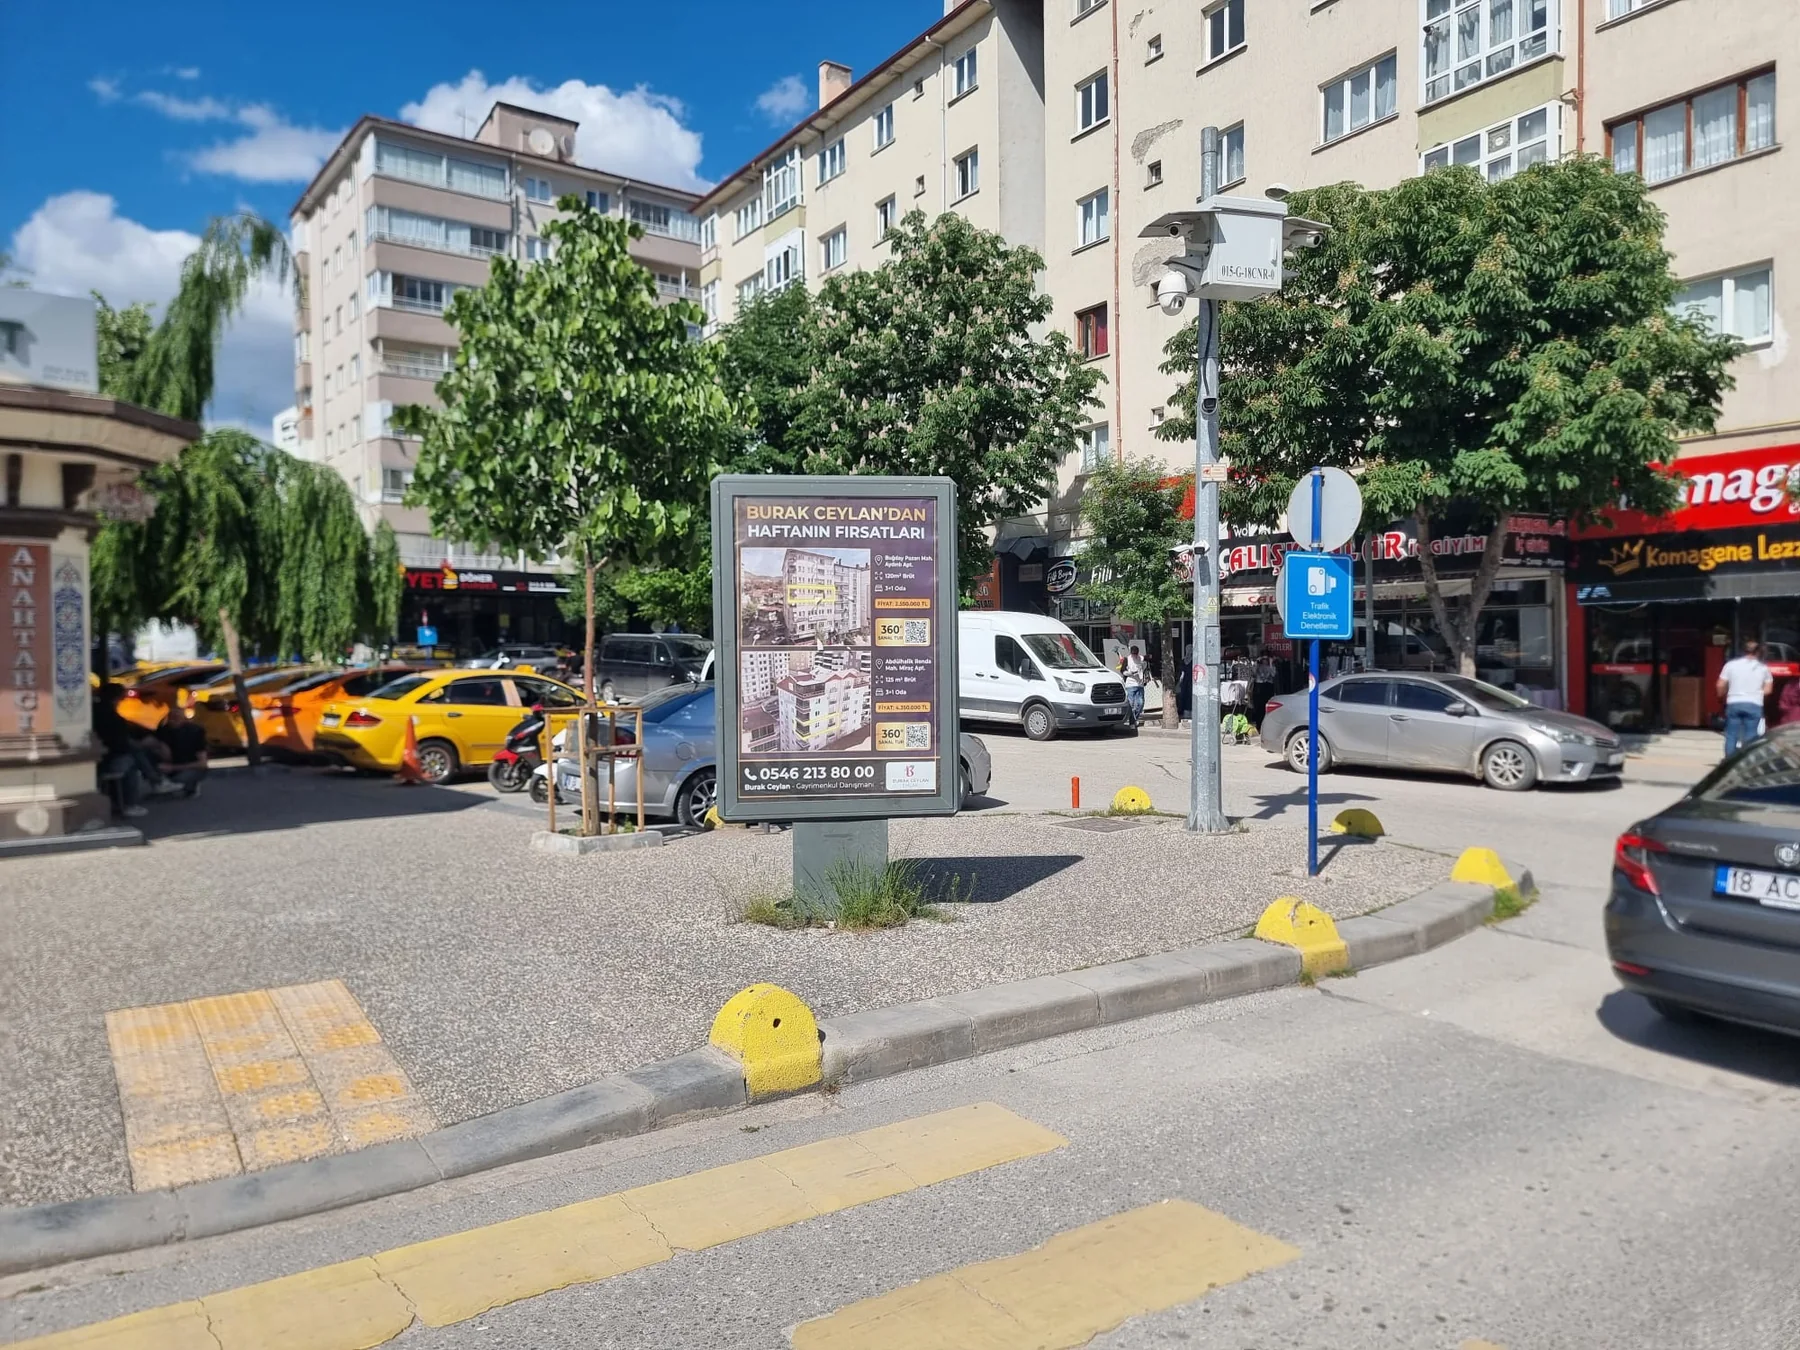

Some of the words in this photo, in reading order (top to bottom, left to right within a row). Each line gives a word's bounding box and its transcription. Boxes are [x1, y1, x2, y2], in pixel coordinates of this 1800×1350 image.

[746, 506, 809, 520] BURAK
[747, 525, 830, 538] HAFTANIN
[835, 526, 925, 539] FIRSATLARI
[1430, 534, 1488, 556] GİYİM
[1646, 545, 1753, 571] Komagene
[1311, 602, 1329, 610] Trafik
[1303, 612, 1337, 620] Elektronik
[1301, 621, 1339, 630] Denetleme
[759, 767, 799, 780] 0546
[803, 766, 827, 779] 213
[830, 766, 850, 779] 80
[854, 766, 875, 778] 00
[744, 783, 766, 791] Burak
[767, 782, 791, 791] Ceylan
[796, 781, 838, 791] Gayrimenkul
[839, 780, 875, 790] Danışmanı
[1732, 871, 1752, 892] 18
